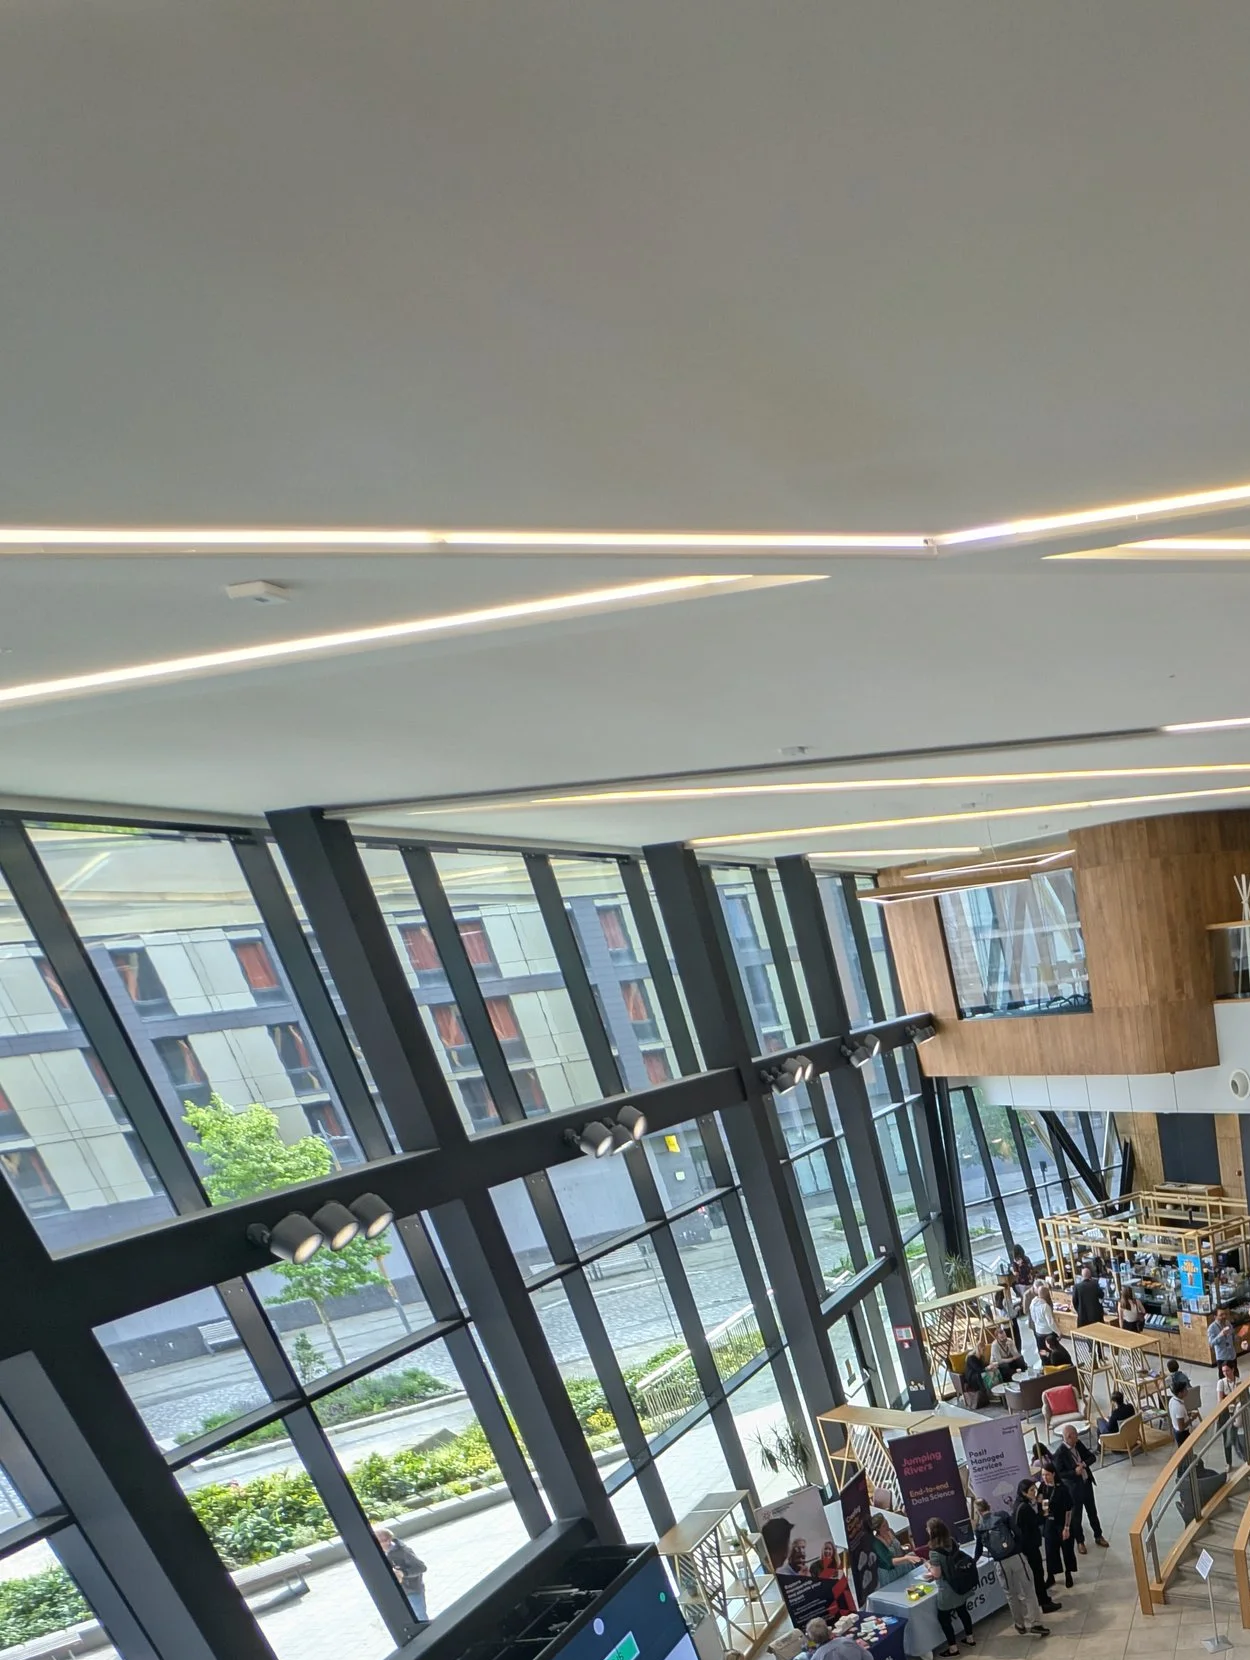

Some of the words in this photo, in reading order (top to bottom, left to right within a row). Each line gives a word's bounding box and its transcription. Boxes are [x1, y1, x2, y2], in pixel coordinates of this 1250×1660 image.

[903, 1451, 942, 1467] Jumping
[969, 1449, 987, 1458] Posit
[970, 1452, 1004, 1466] Managed
[903, 1463, 933, 1476] Rivers
[973, 1462, 1002, 1473] Services
[909, 1481, 949, 1497] End-to-end
[912, 1496, 930, 1505] Data
[929, 1489, 955, 1501] Science
